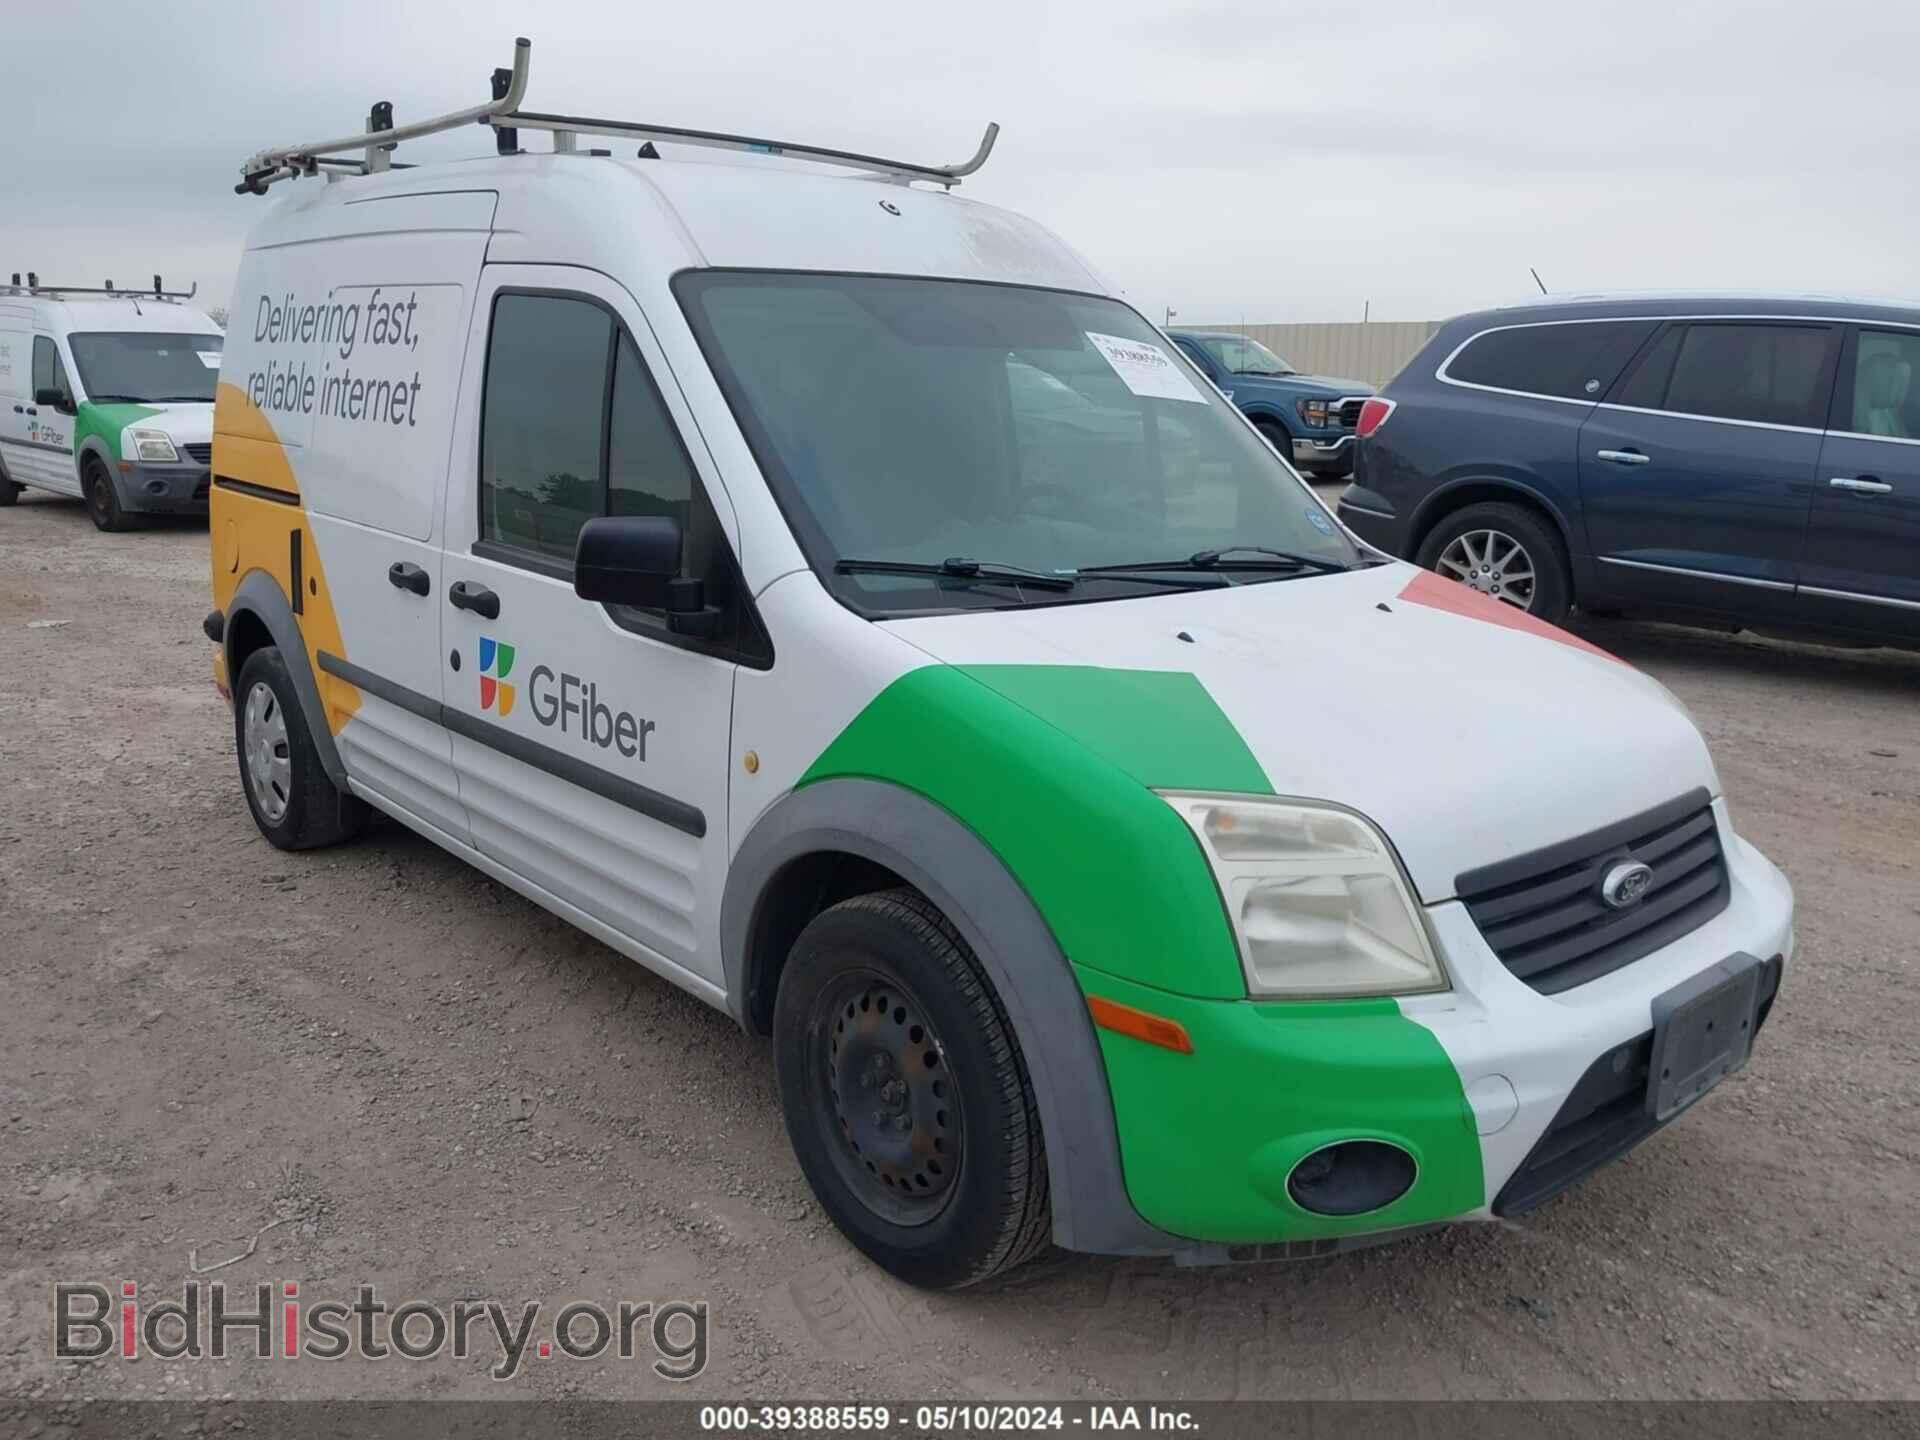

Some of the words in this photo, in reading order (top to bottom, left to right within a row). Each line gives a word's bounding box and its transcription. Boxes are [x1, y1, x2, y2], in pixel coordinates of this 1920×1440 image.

[255, 290, 360, 360] Delivering
[364, 288, 418, 352] fast,
[247, 360, 315, 414] reliable
[320, 362, 421, 427] internet
[529, 665, 655, 762] GFiber
